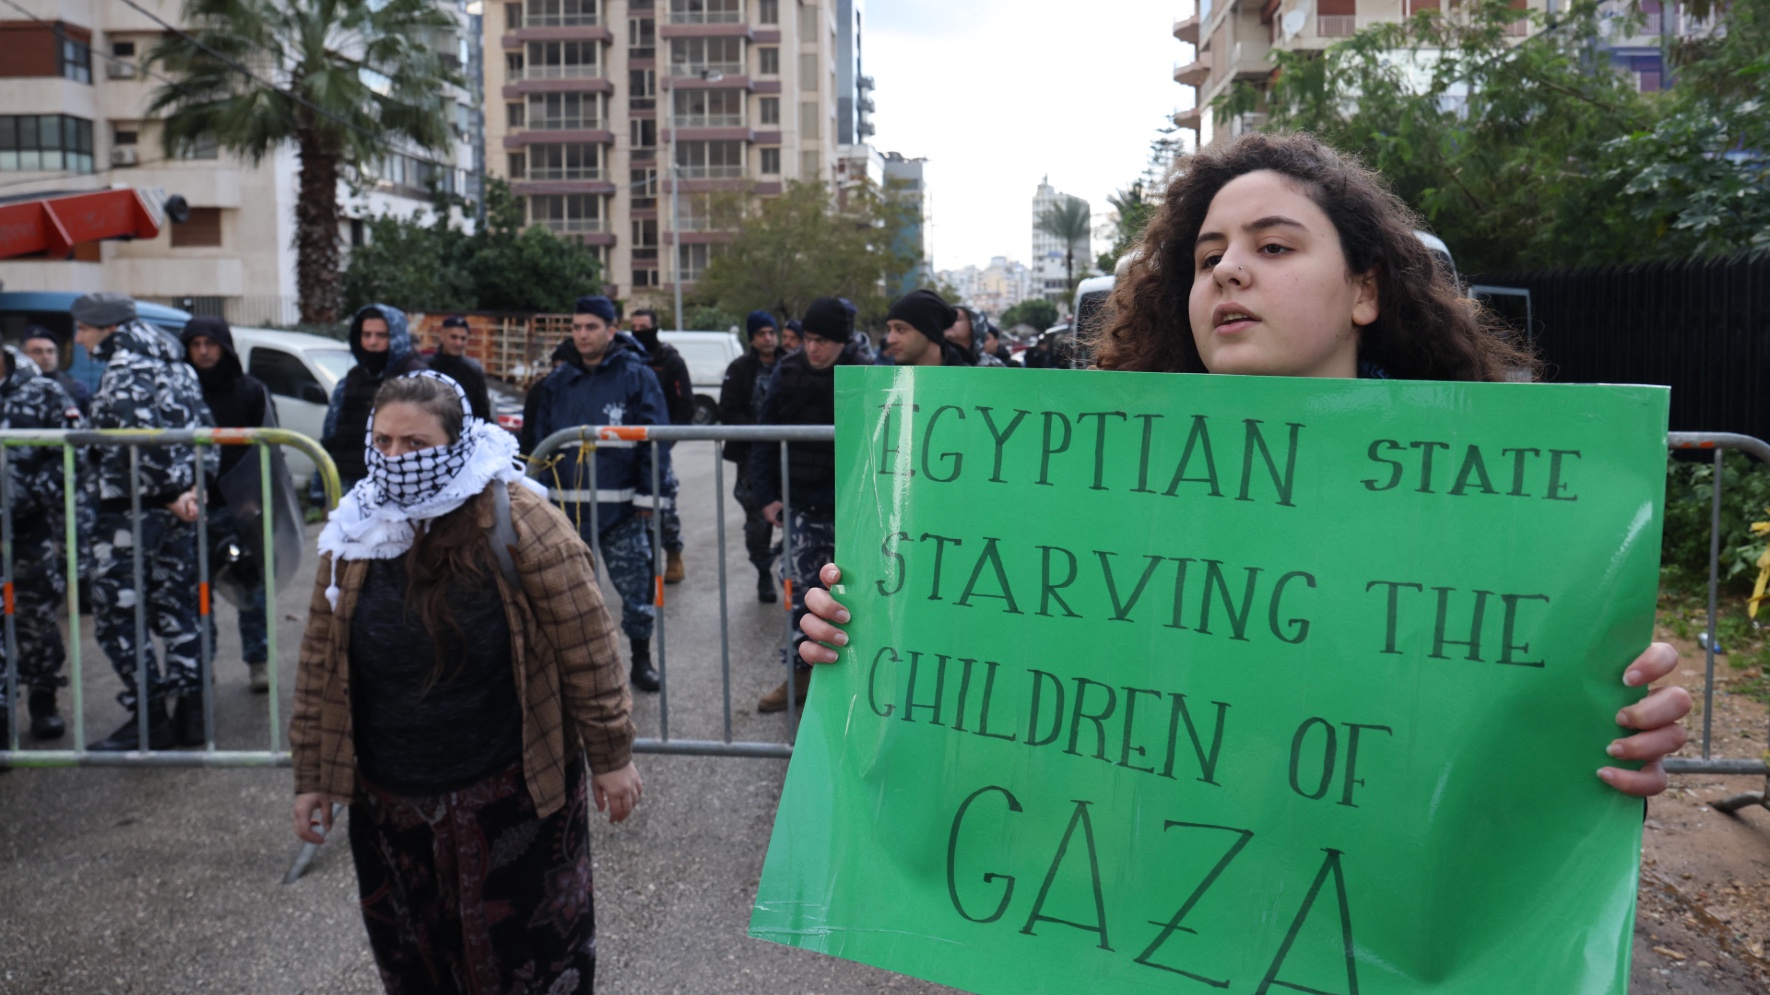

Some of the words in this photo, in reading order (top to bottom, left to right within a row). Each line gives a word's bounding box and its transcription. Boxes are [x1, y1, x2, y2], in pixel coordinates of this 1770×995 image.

[877, 403, 1305, 507] EGYPTIAN
[1360, 439, 1582, 501] STATE
[875, 531, 1317, 645] STARVING
[1365, 580, 1550, 668] THE
[868, 646, 1231, 787] CHILDREN
[1288, 716, 1392, 808] OF
[946, 785, 1360, 995] GAZA
